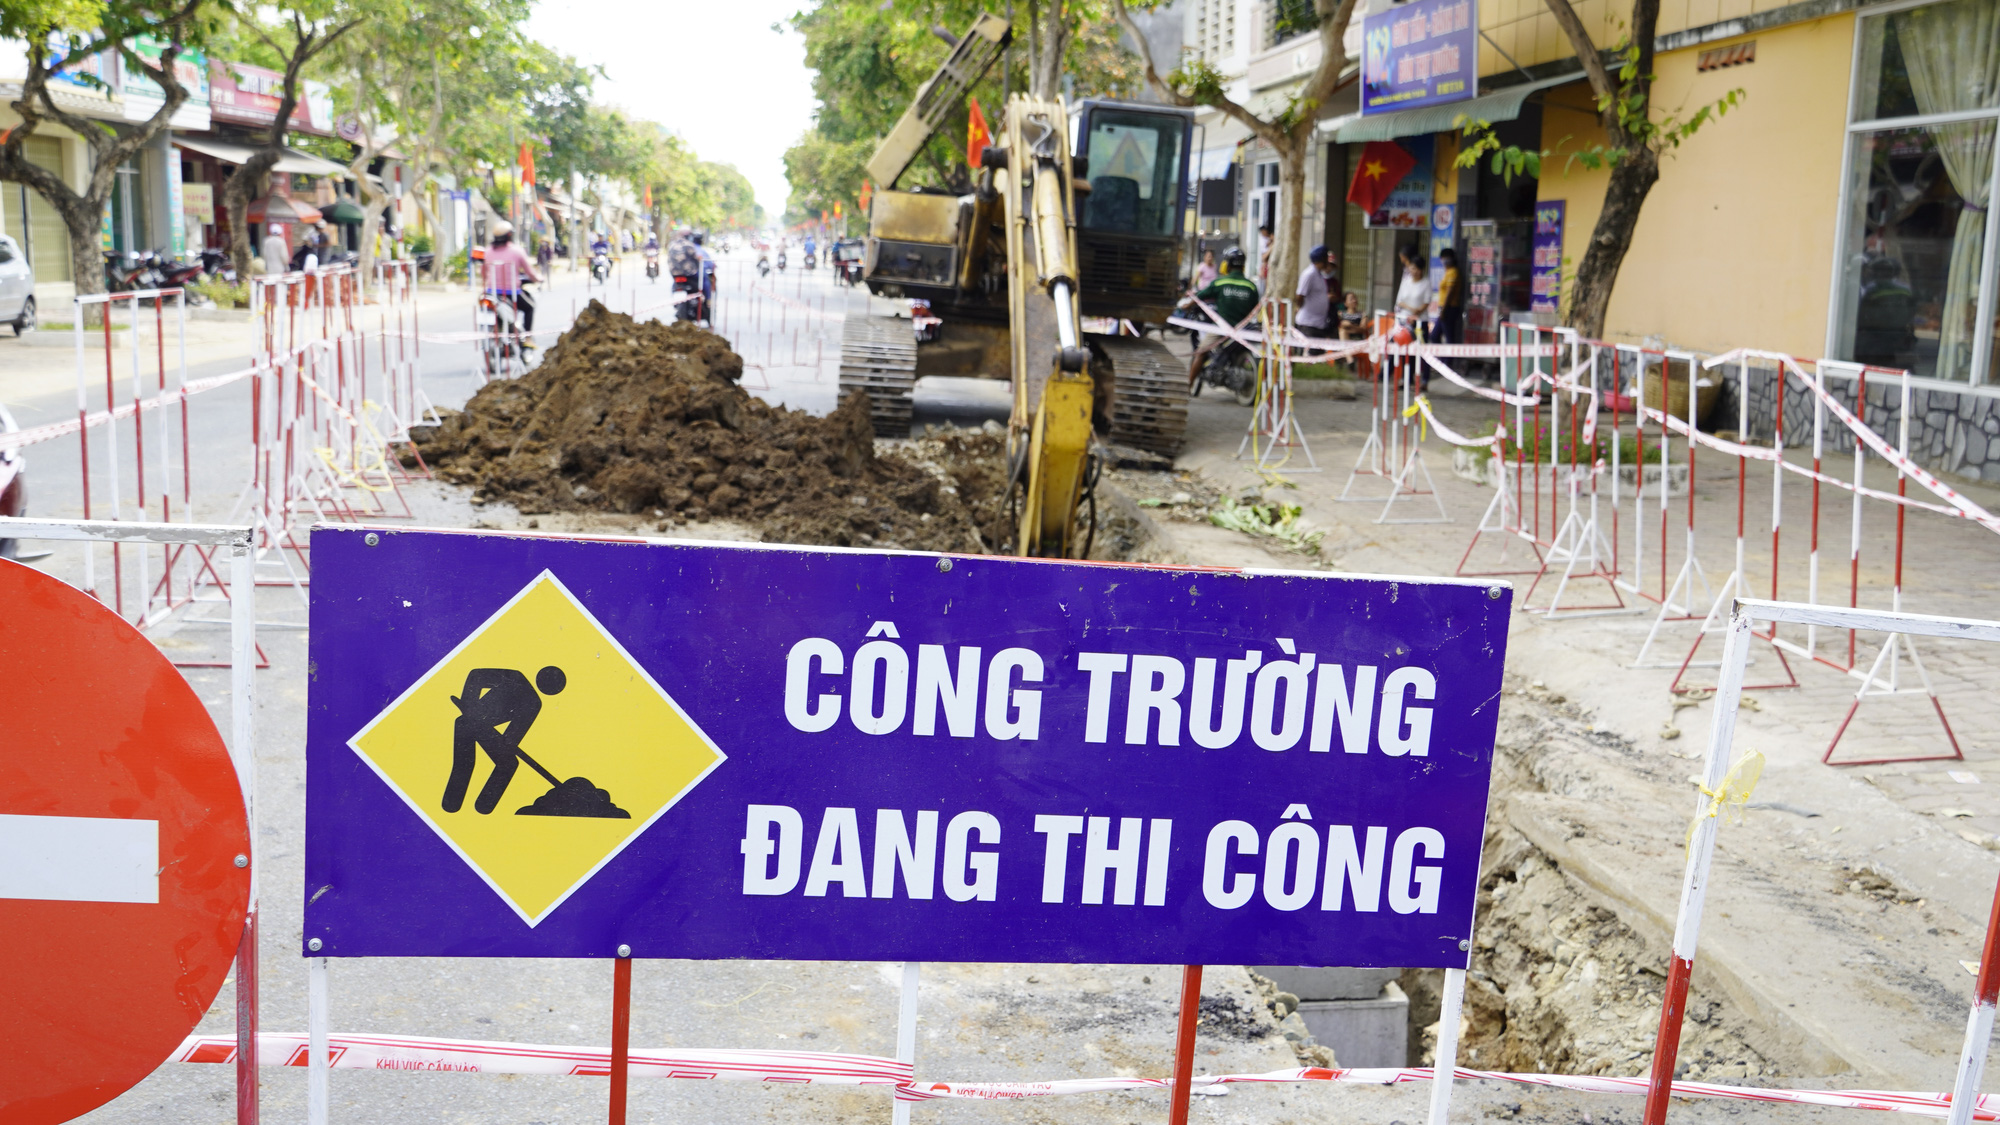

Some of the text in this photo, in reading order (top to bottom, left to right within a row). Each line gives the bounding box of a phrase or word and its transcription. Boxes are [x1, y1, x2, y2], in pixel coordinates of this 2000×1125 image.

[785, 621, 1437, 757] CÔNG TRƯỜNG
[741, 803, 1446, 914] ĐANG THI CÔNG
